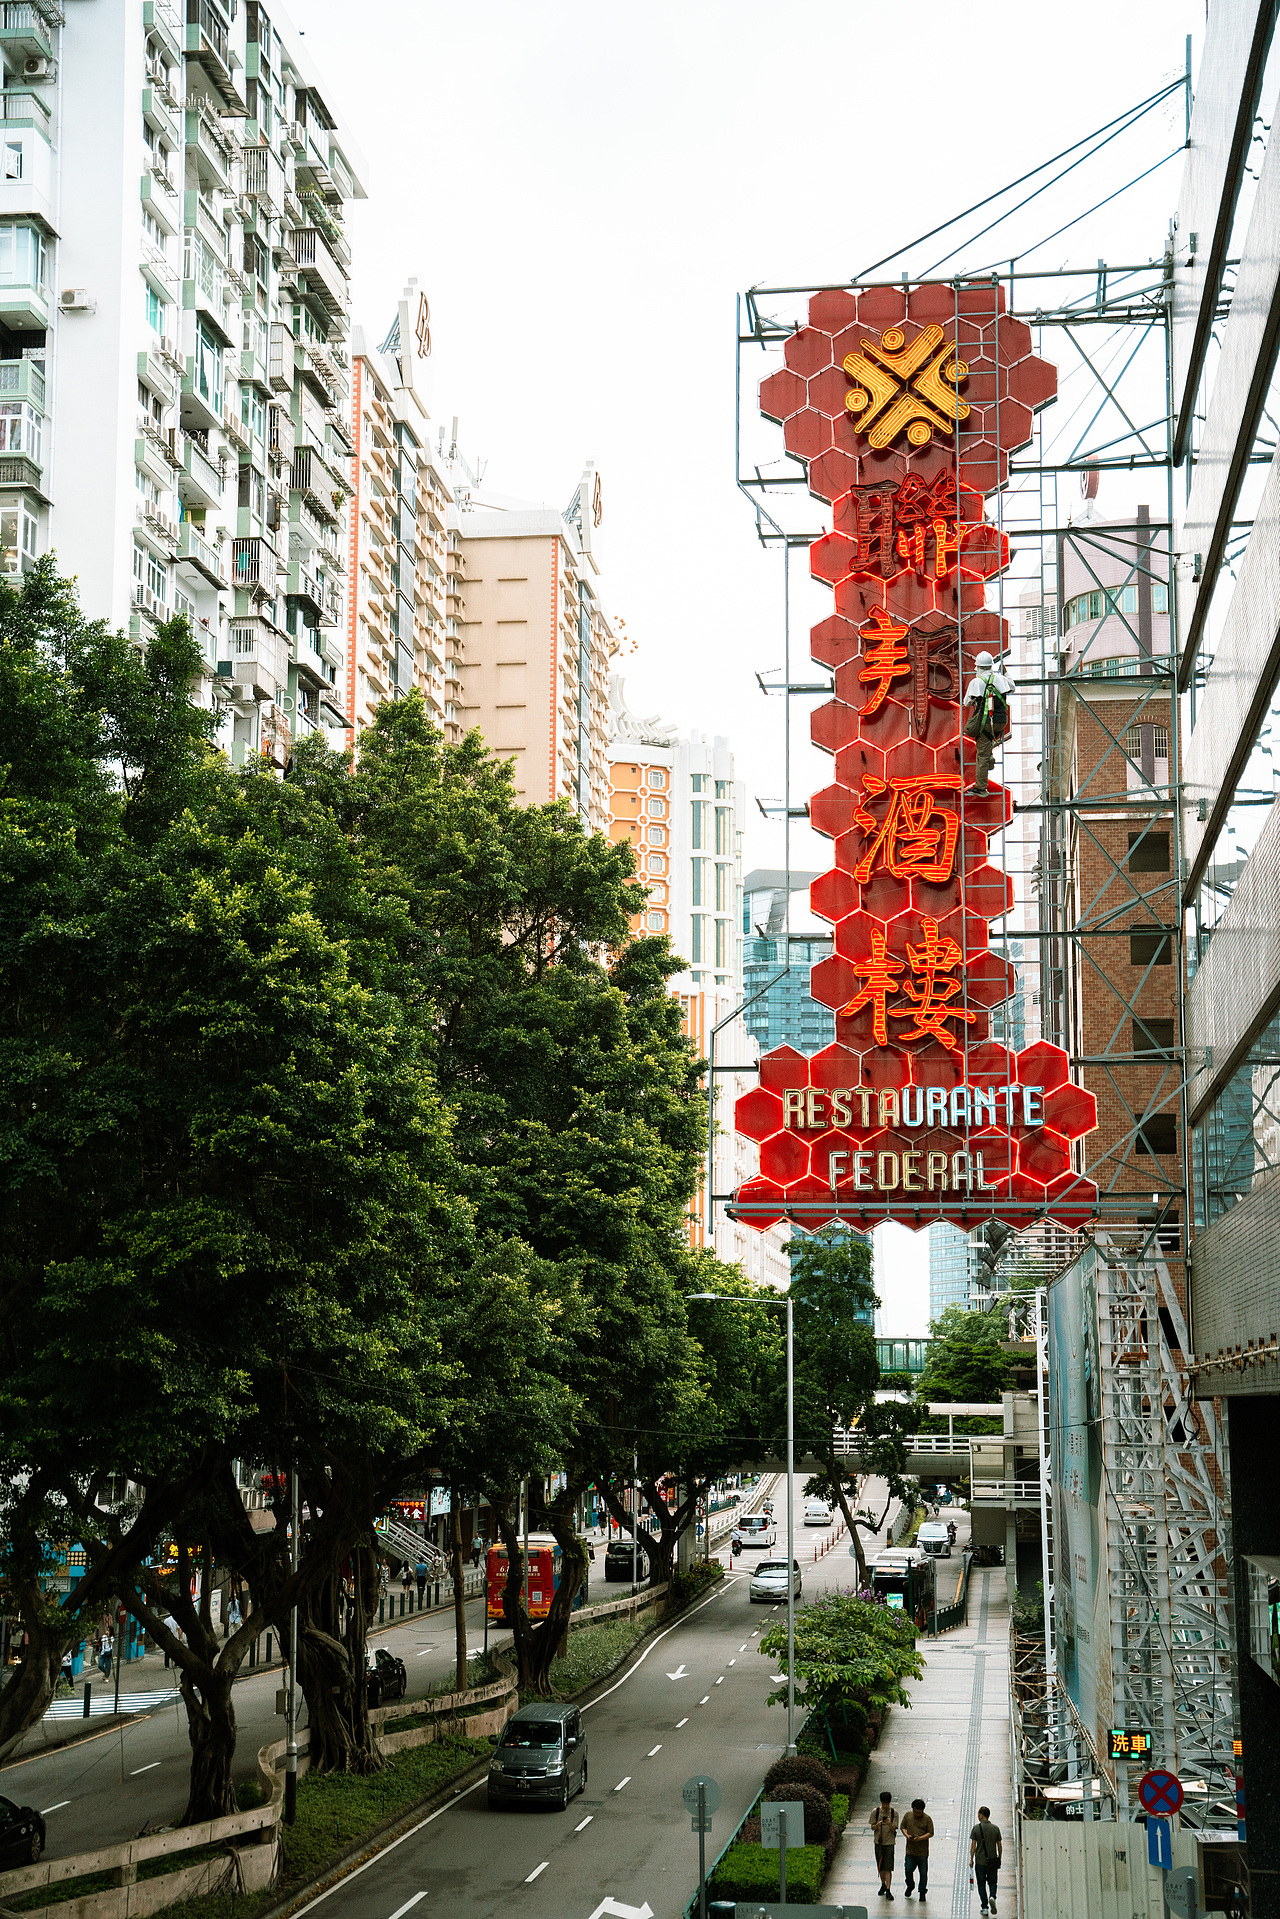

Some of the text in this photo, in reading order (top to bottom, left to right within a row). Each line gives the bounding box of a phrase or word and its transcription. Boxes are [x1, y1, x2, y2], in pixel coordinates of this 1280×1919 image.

[839, 467, 977, 1050] 聯邦酒樓
[782, 1085, 1045, 1129] RESTAURANTE
[828, 1149, 998, 1192] FEDERAL
[1112, 1734, 1148, 1753] 洗車
[1065, 1804, 1085, 1816] 的士
